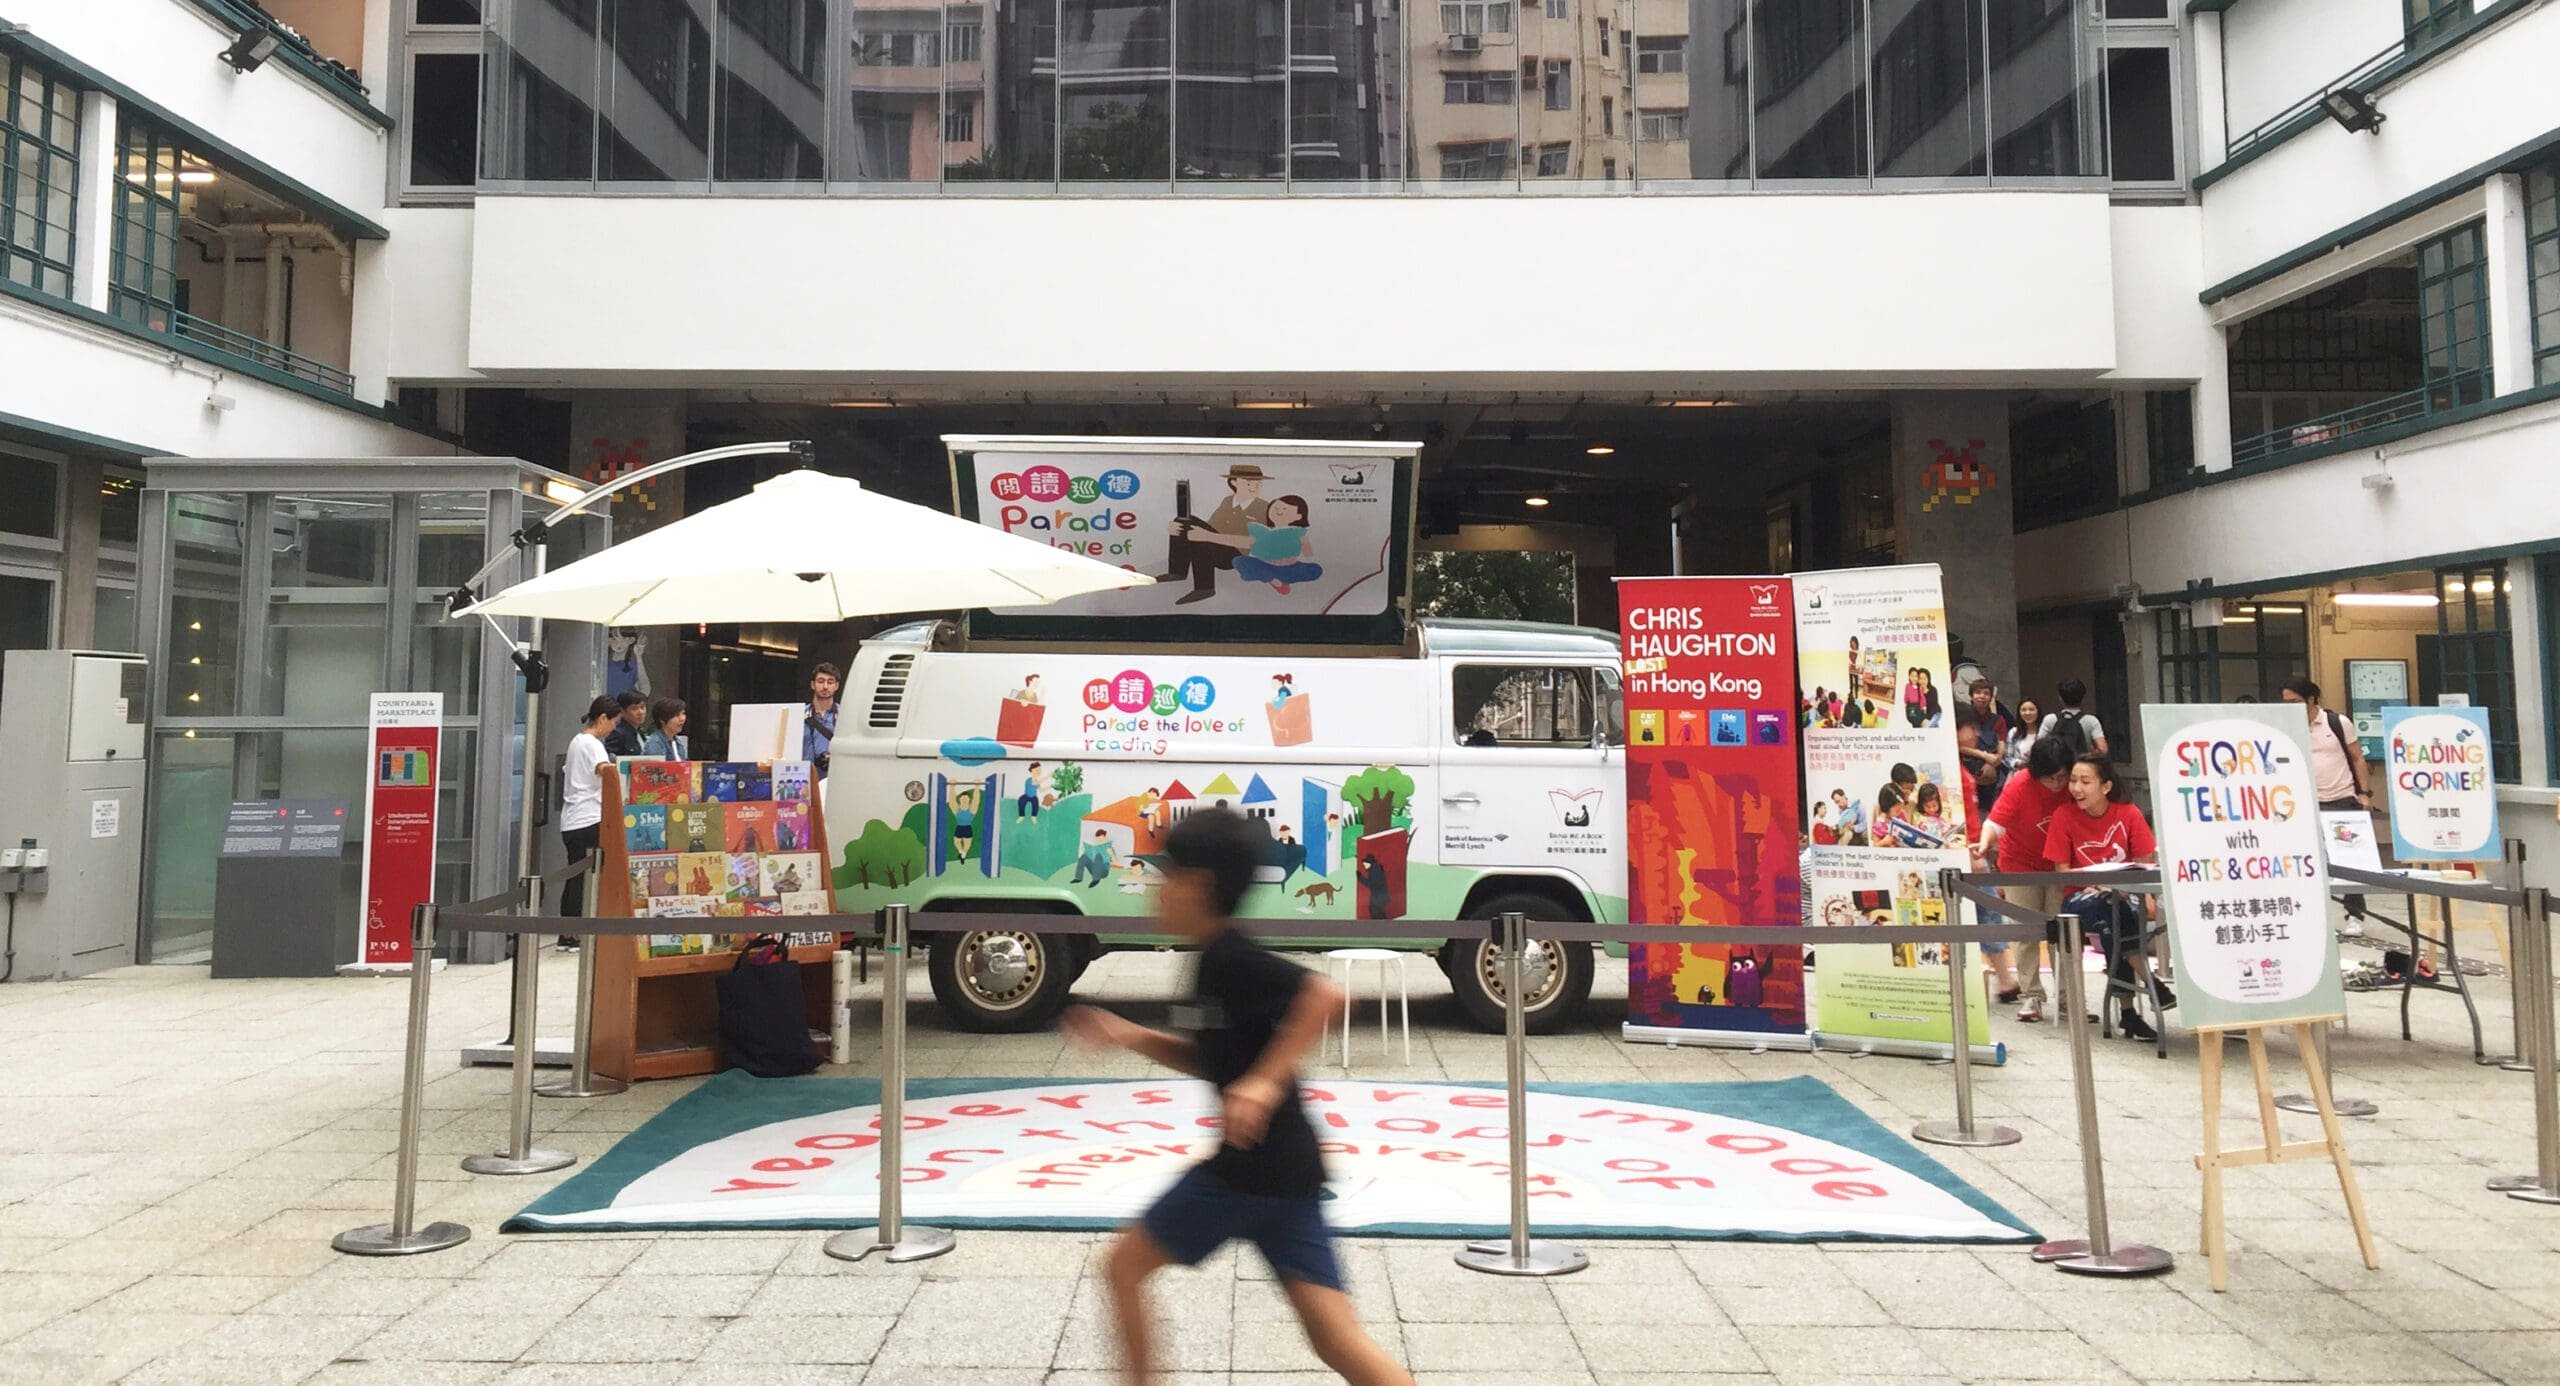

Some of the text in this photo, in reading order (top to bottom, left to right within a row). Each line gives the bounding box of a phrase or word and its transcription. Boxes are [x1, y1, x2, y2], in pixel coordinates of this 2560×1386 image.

[997, 472, 1132, 499] 閱讀巡禮
[1001, 505, 1137, 533] Parade
[1109, 539, 1133, 556] of
[1629, 607, 1704, 630] CHRIS
[1630, 633, 1776, 657] HAUGHTON
[1625, 657, 1665, 674] LOST
[1089, 678, 1208, 710] 閱讀巡禮
[1631, 672, 1762, 700] in Hong Kong
[1083, 714, 1246, 733] Parade the love of
[1085, 737, 1168, 756] reading
[2176, 740, 2290, 778] STORY-
[2394, 743, 2484, 765] READING
[2399, 770, 2485, 792] CORNER
[2177, 785, 2296, 823] TELLING
[2226, 829, 2260, 849] with
[2177, 855, 2315, 882] ARTS & CRAFTS
[2215, 923, 2290, 945] 創意小手工
[1579, 1109, 1889, 1201] made
[876, 1149, 1004, 1183] on
[1603, 1159, 1716, 1190] of
[1016, 1142, 1573, 1198] their arents
